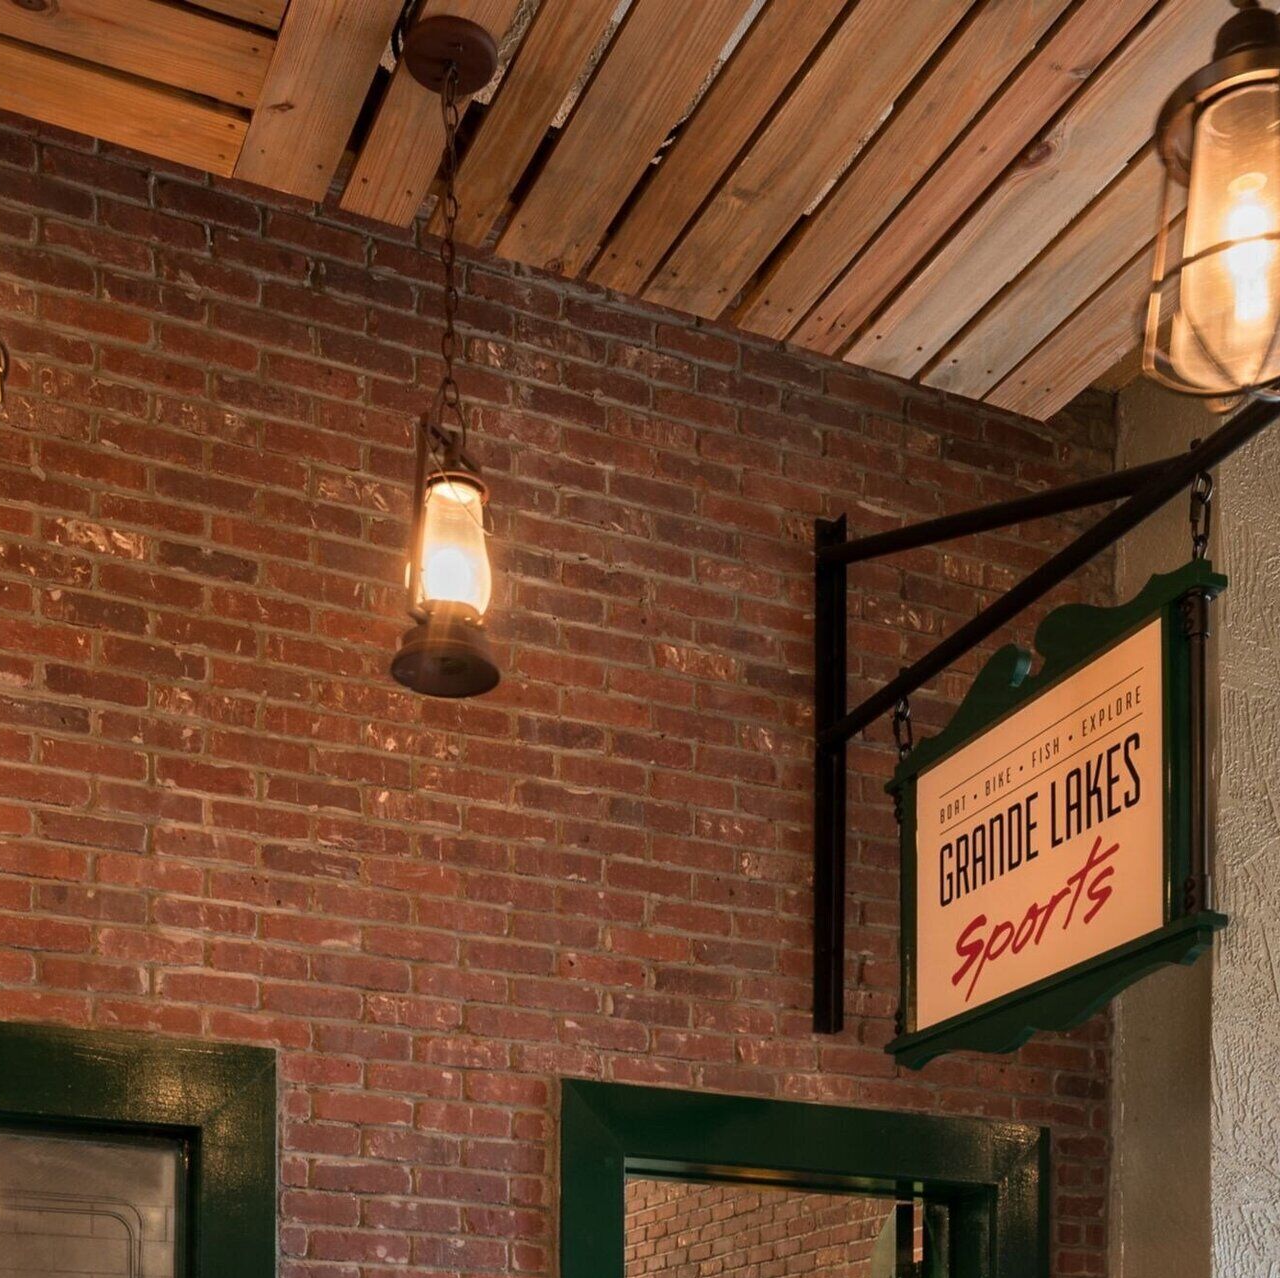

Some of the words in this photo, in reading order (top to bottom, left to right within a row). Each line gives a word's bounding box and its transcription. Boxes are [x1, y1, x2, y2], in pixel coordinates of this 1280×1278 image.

[940, 794, 967, 823] BOAT
[985, 766, 1011, 797] BIKE
[1032, 741, 1060, 767] FISH
[1082, 686, 1141, 737] EXPLORE
[940, 792, 1038, 907] GRANDE
[1051, 732, 1141, 847] LAKES
[951, 836, 1119, 1002] Sports
